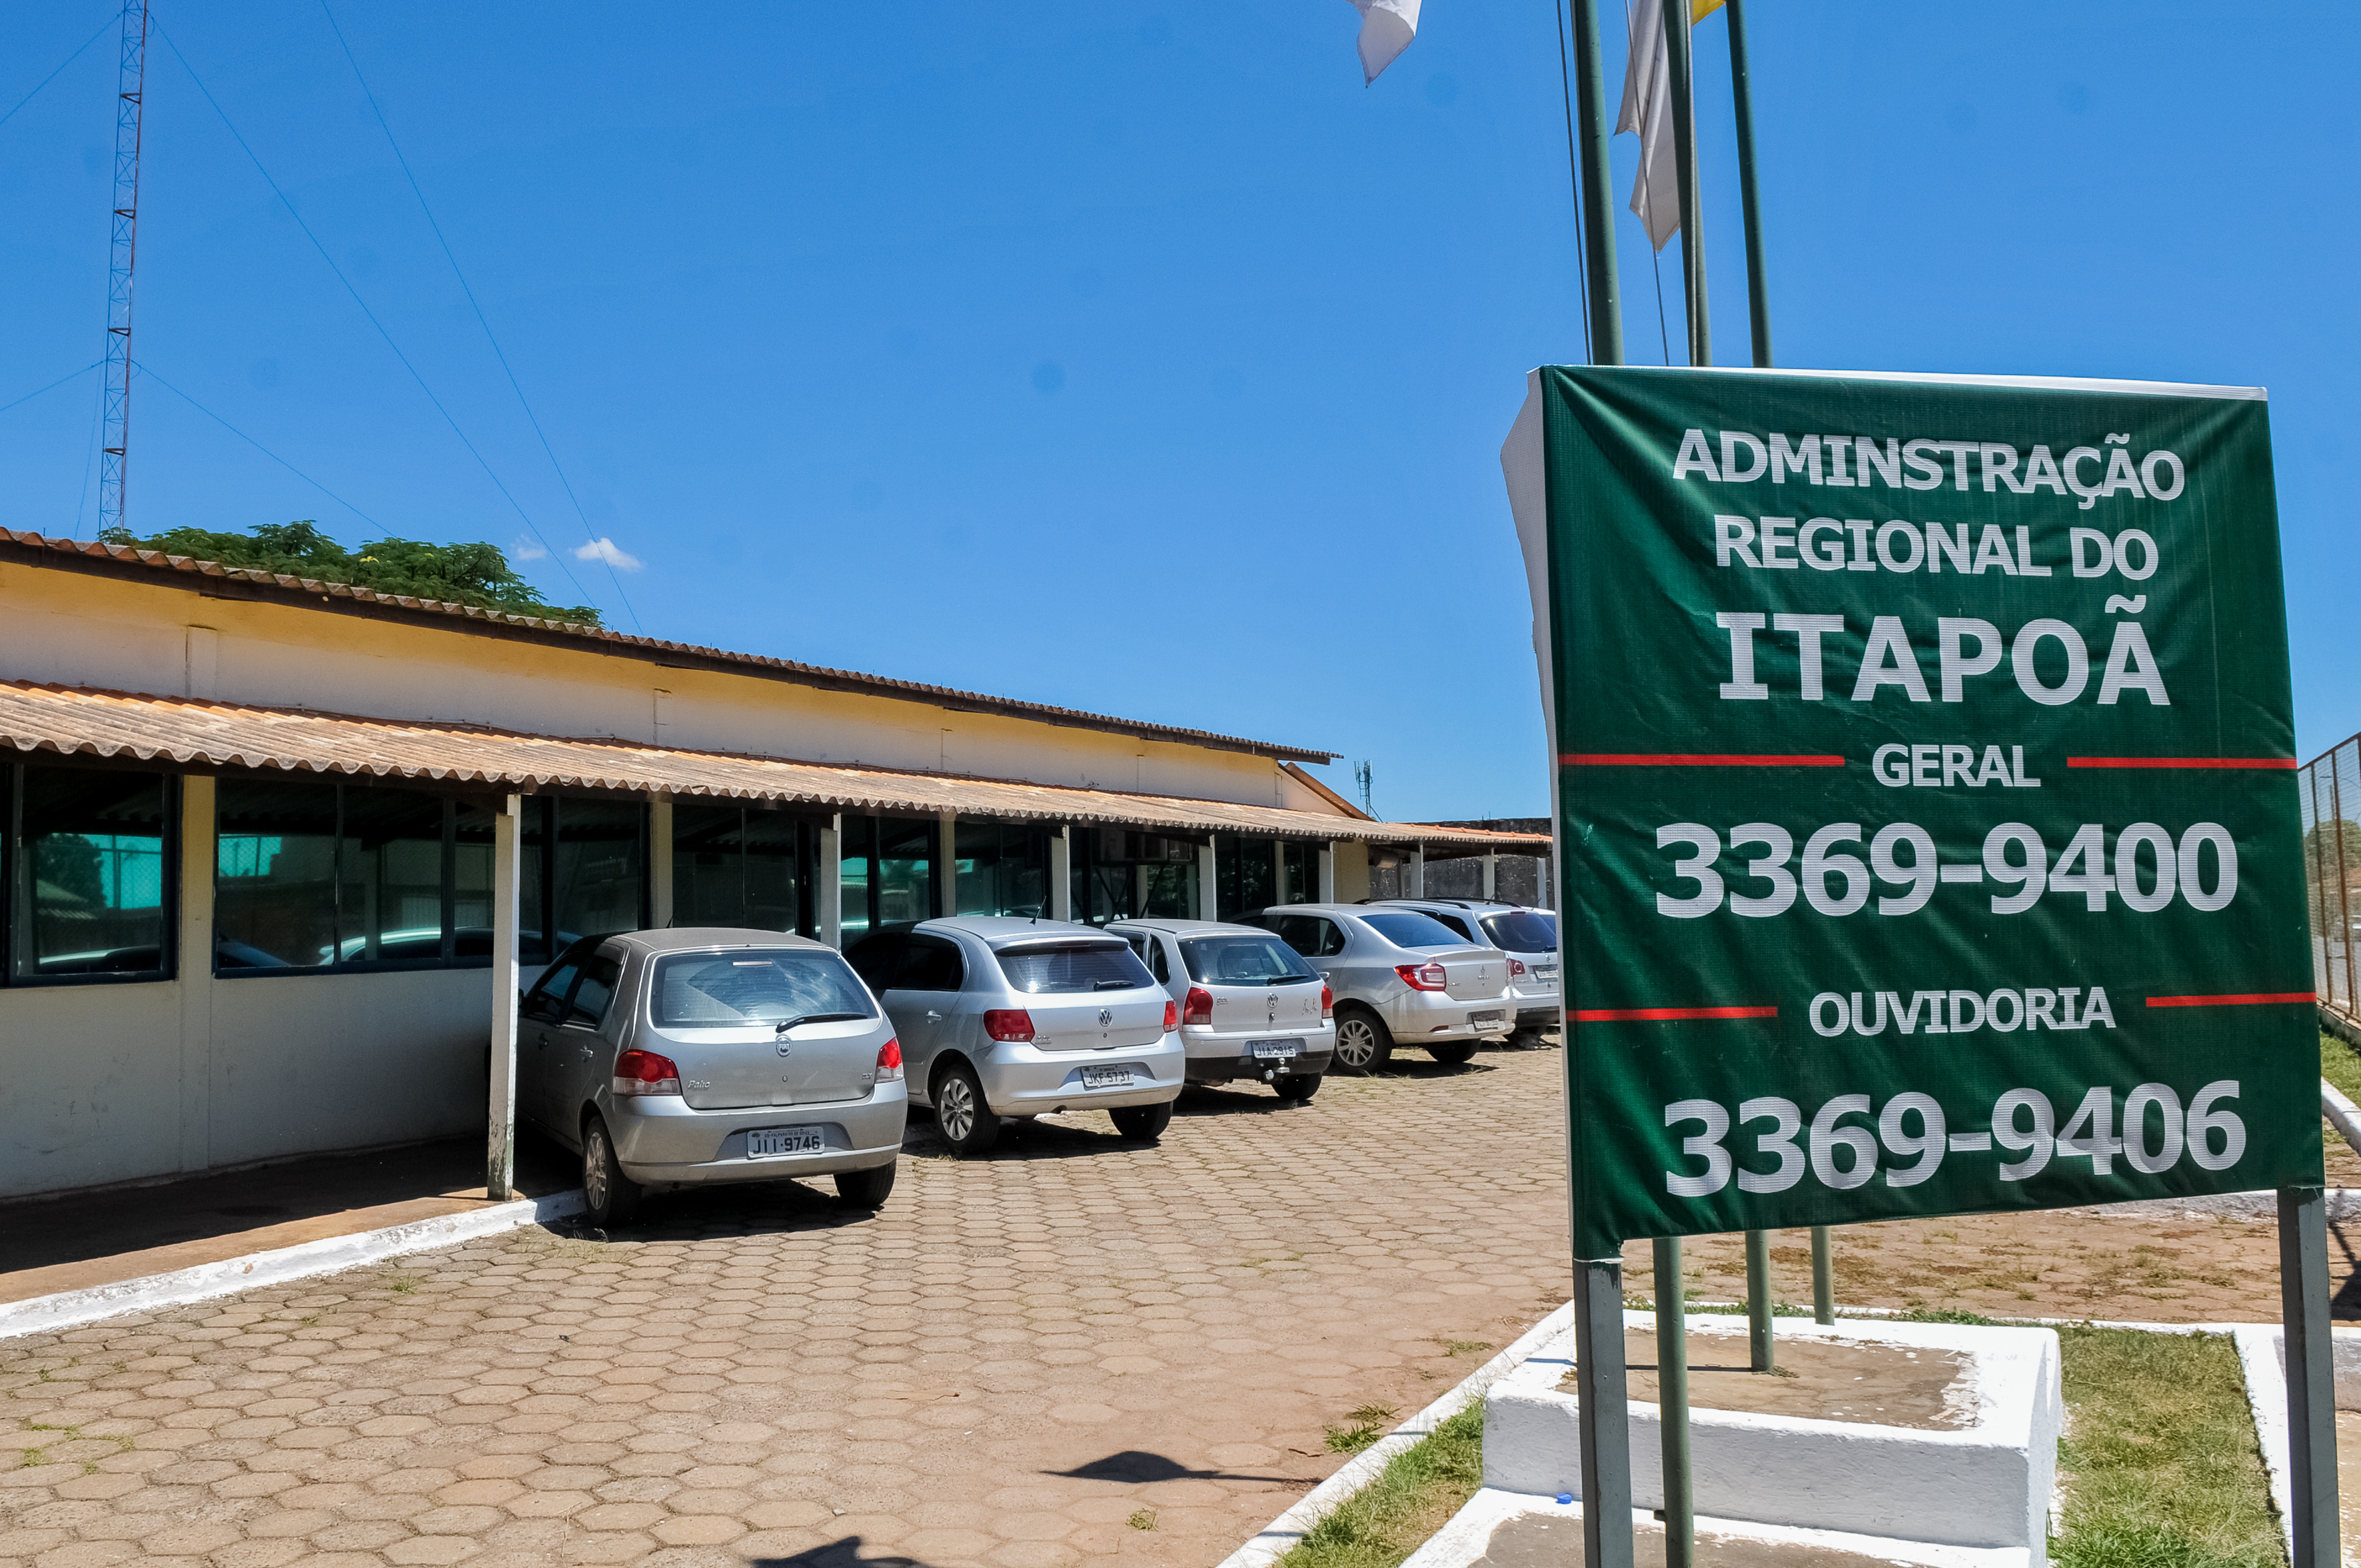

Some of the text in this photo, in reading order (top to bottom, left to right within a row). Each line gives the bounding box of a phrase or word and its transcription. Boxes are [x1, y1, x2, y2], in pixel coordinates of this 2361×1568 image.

[1672, 428, 2185, 510] ADMINSTRAÇÃO
[1713, 514, 2159, 580] REGIONAL DO
[1715, 594, 2171, 706] ITAPOÃ
[1872, 743, 2041, 787] GERAL
[1656, 822, 2238, 918] 3369-9400
[1809, 986, 2116, 1037] OUVIDORIA
[1665, 1080, 2246, 1197] 3369-9406
